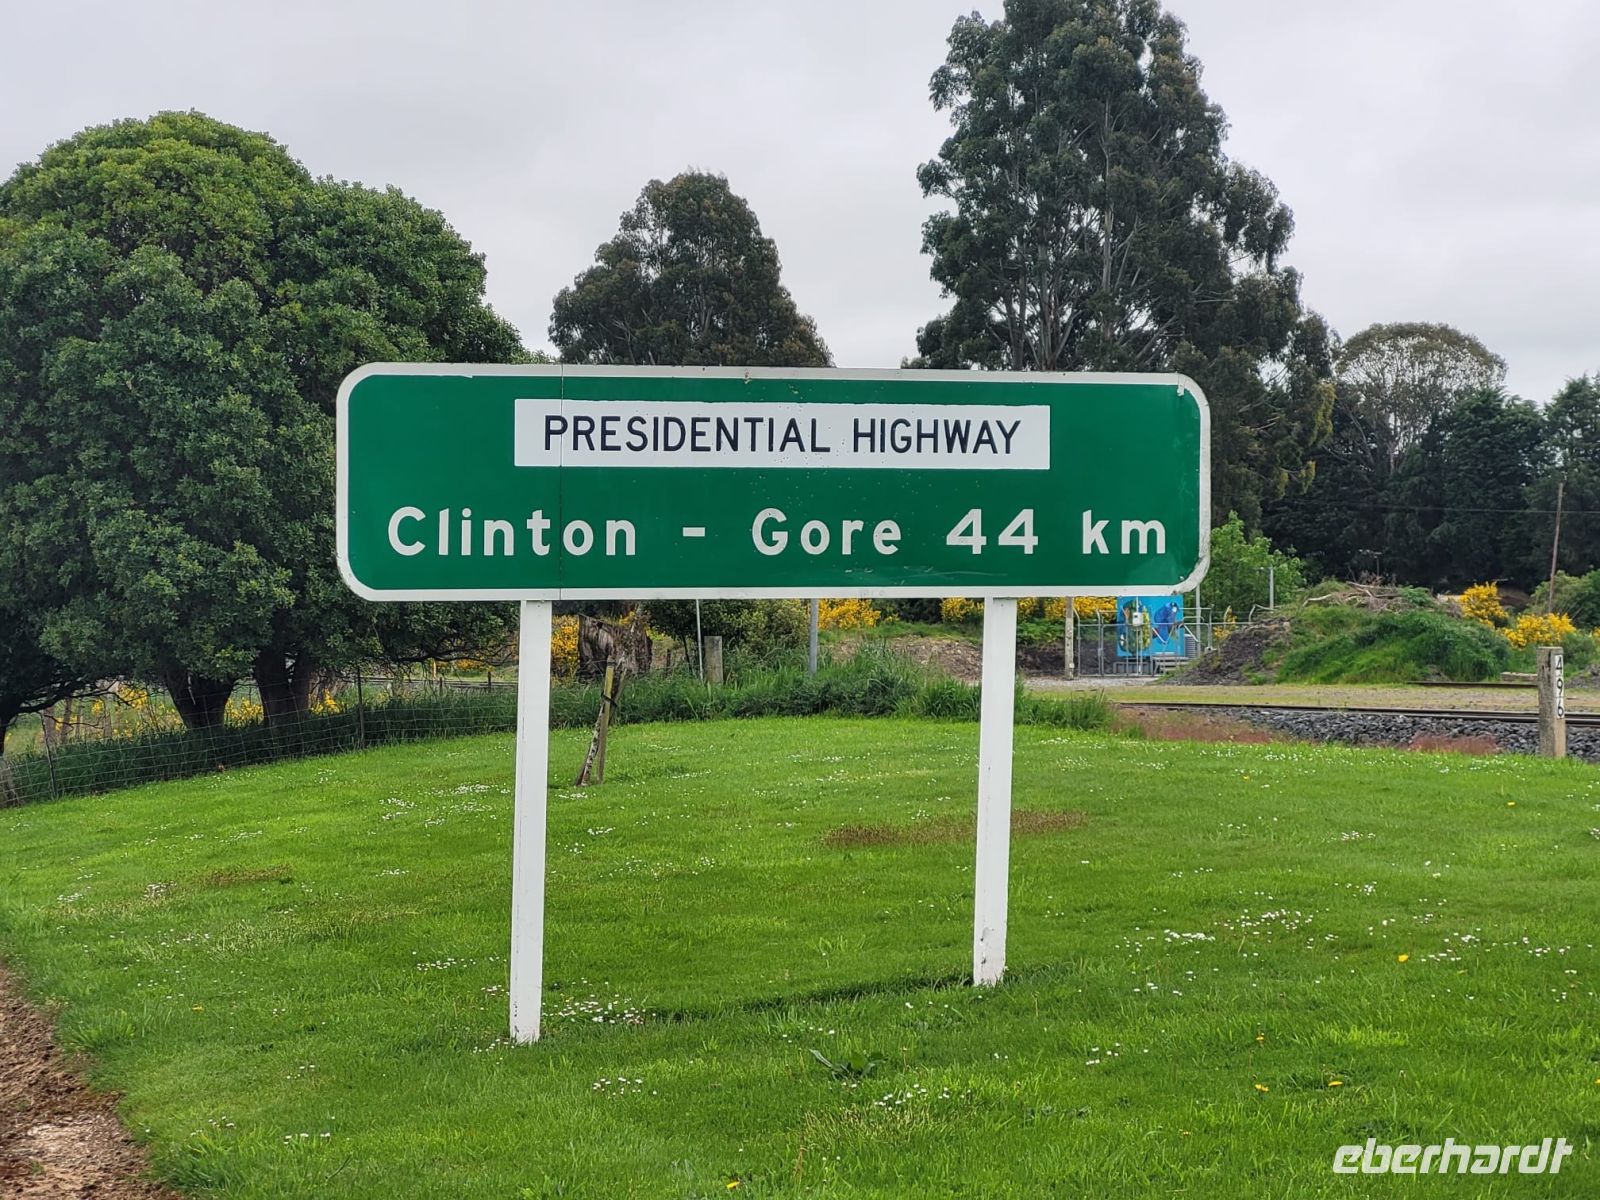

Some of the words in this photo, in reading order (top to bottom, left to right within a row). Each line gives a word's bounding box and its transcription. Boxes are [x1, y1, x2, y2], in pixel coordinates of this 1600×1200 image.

[545, 415, 831, 453] PRESIDENTIAL
[853, 418, 1021, 455] HIGHWAY
[387, 507, 636, 557] Clinton
[752, 508, 902, 557] Gore
[946, 508, 1039, 555] 44
[1082, 509, 1166, 556] km
[1555, 655, 1564, 717] 496
